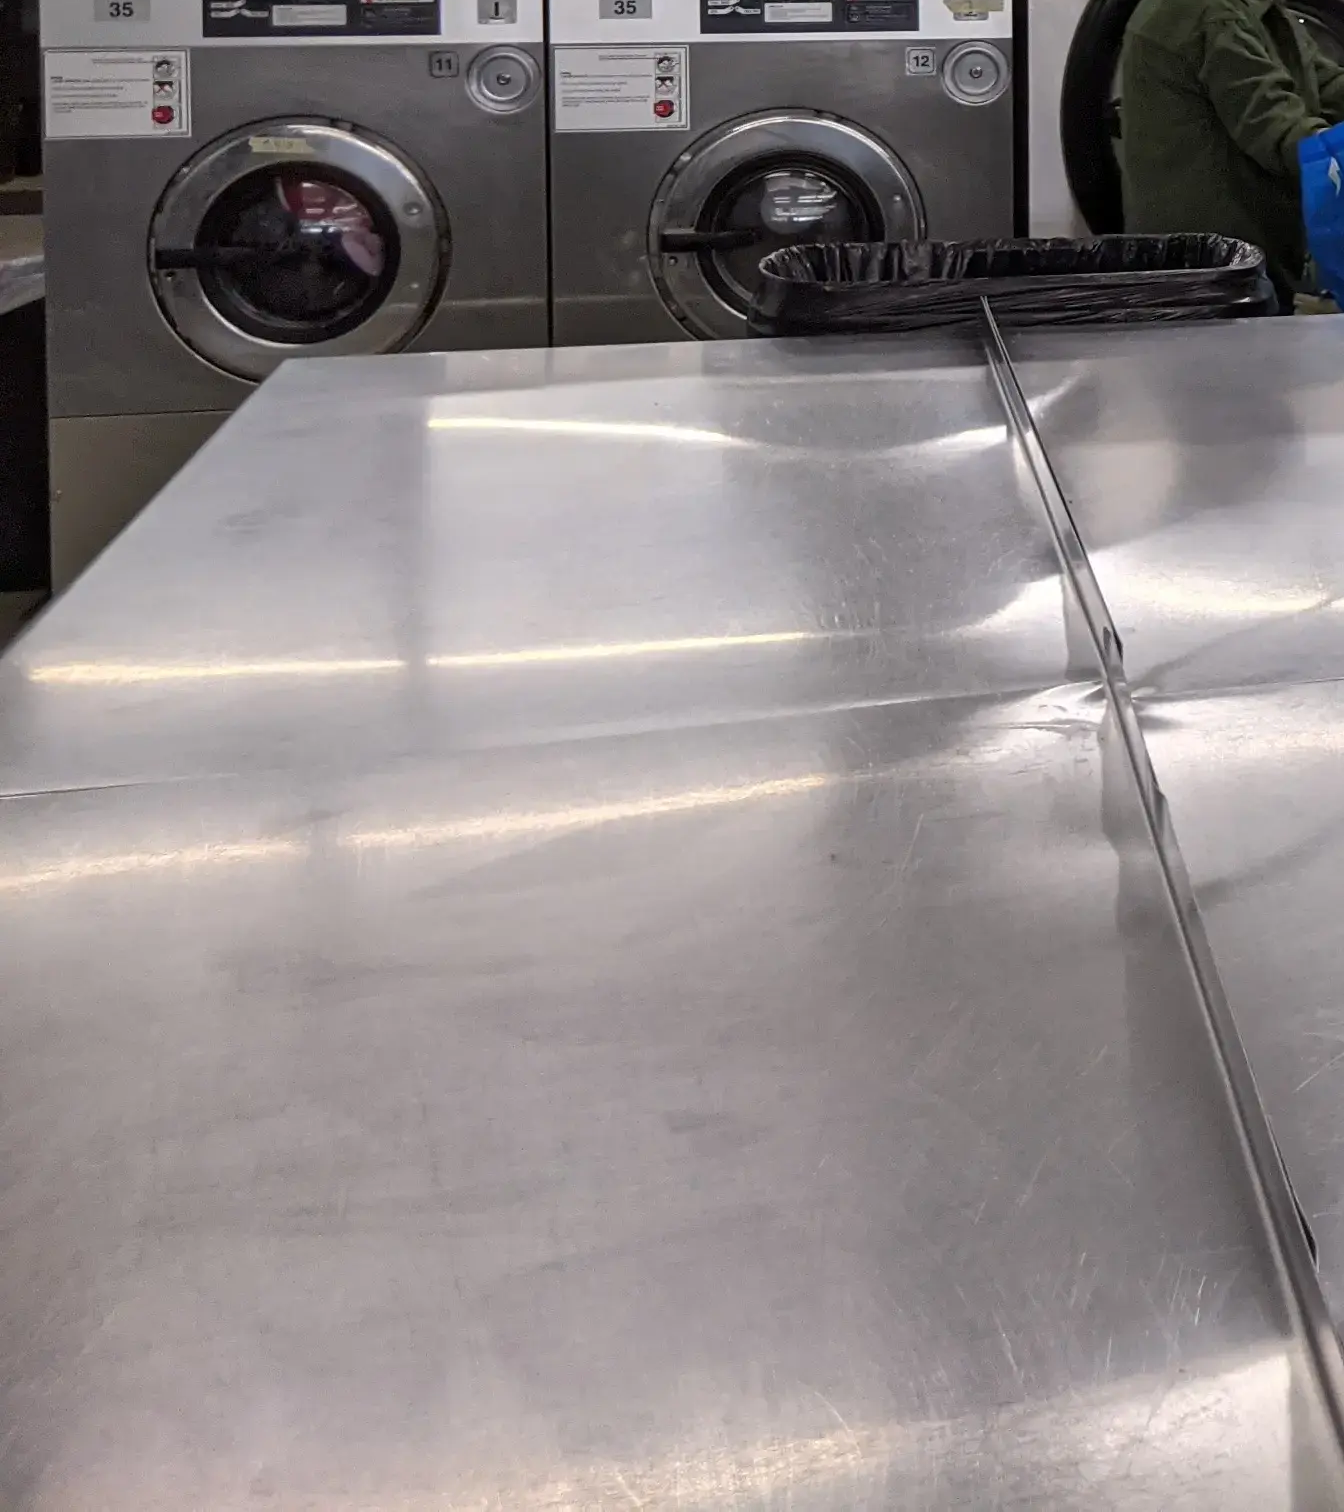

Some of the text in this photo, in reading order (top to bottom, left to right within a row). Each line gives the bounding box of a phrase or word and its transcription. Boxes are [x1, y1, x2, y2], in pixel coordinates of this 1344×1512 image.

[109, 1, 135, 18] 35
[613, 0, 637, 15] 35
[435, 58, 453, 71] 11
[912, 55, 930, 67] 12
